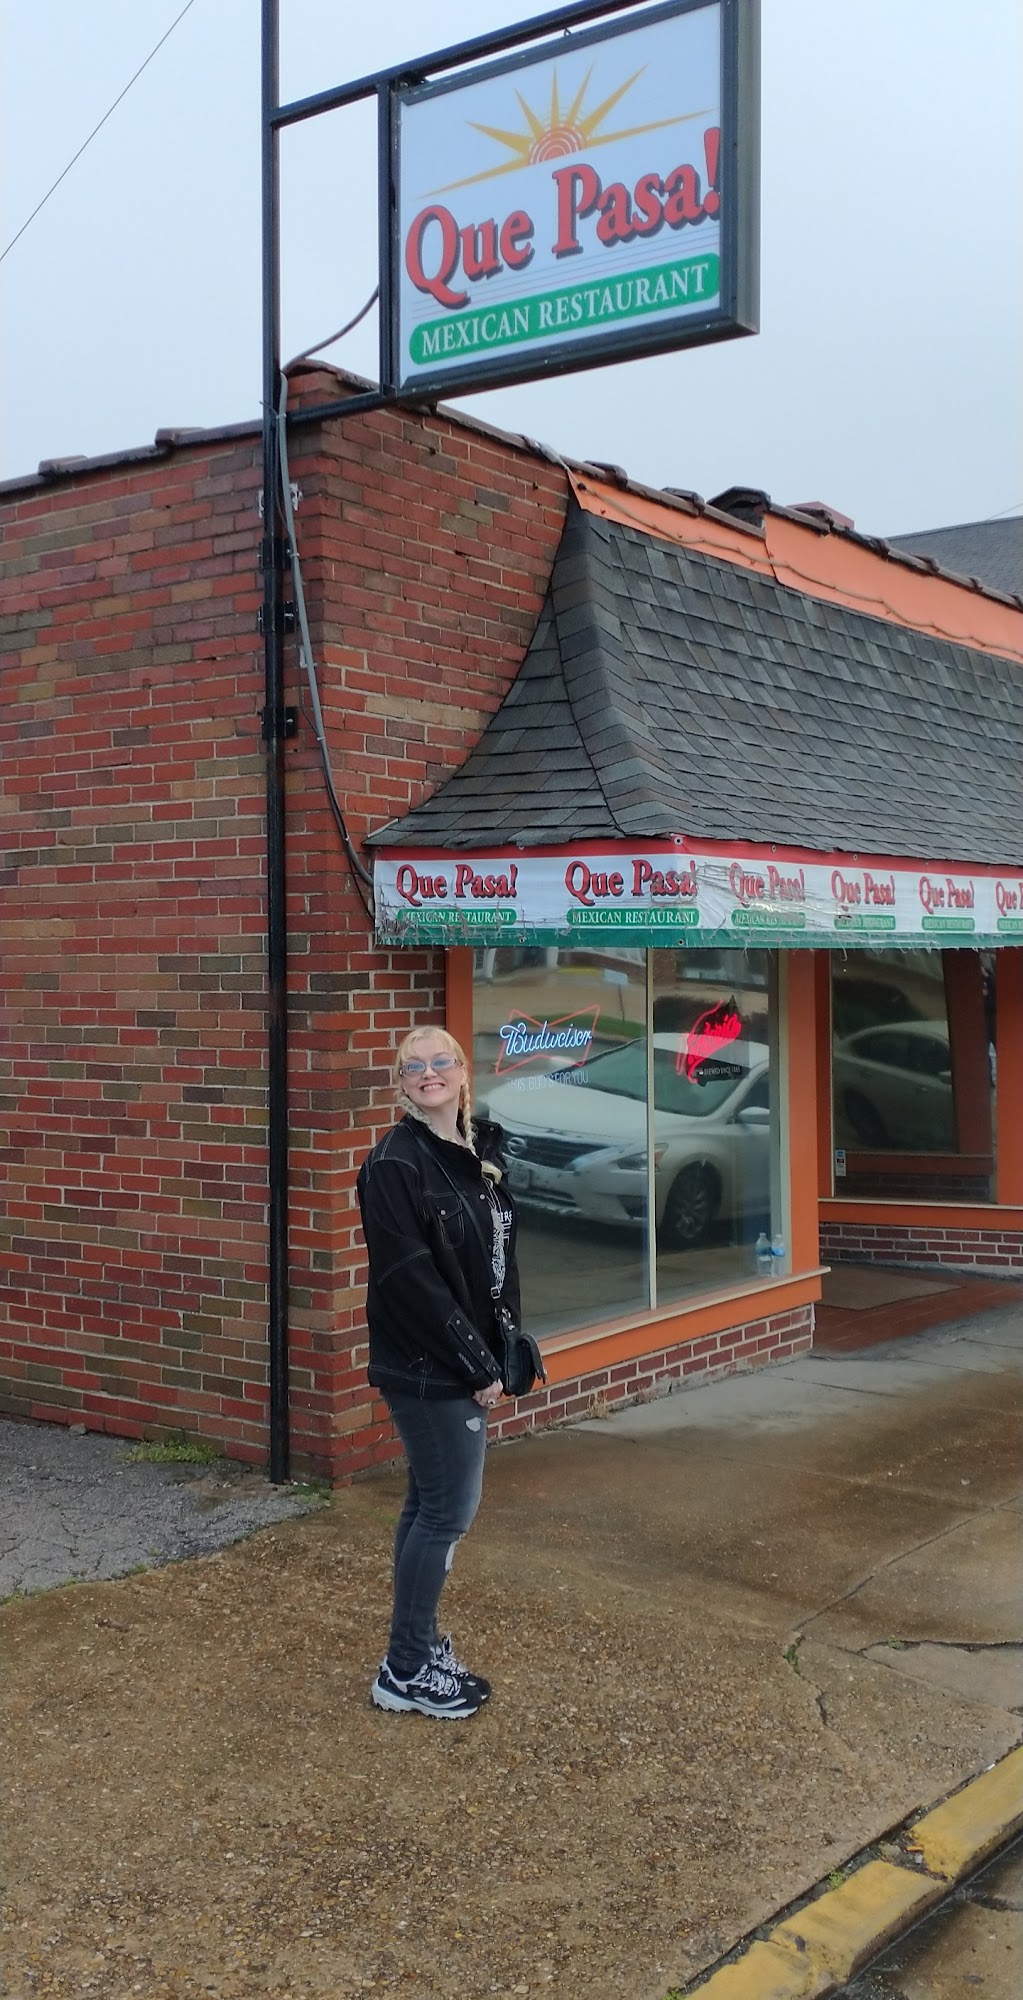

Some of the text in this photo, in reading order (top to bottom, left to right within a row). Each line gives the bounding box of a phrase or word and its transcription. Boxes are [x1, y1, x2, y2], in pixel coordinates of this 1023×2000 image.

[405, 127, 720, 309] Que Pasa!
[421, 262, 709, 357] MEXICAN RESTAURANT
[397, 863, 517, 907] Que Pasa!
[565, 859, 697, 907] Que Pasa!
[729, 862, 765, 908] Que
[831, 870, 896, 912] Que Pasa!
[919, 876, 974, 915] Que Pasa!
[995, 881, 1018, 917] Que
[402, 911, 512, 923] MEXICAN RESTAURANT
[572, 911, 696, 923] MEXICAN RESTAURANT
[500, 1020, 592, 1056] Budweiser
[506, 1076, 526, 1092] THIS
[554, 1071, 571, 1086] FOR
[571, 1070, 591, 1085] YOU.
